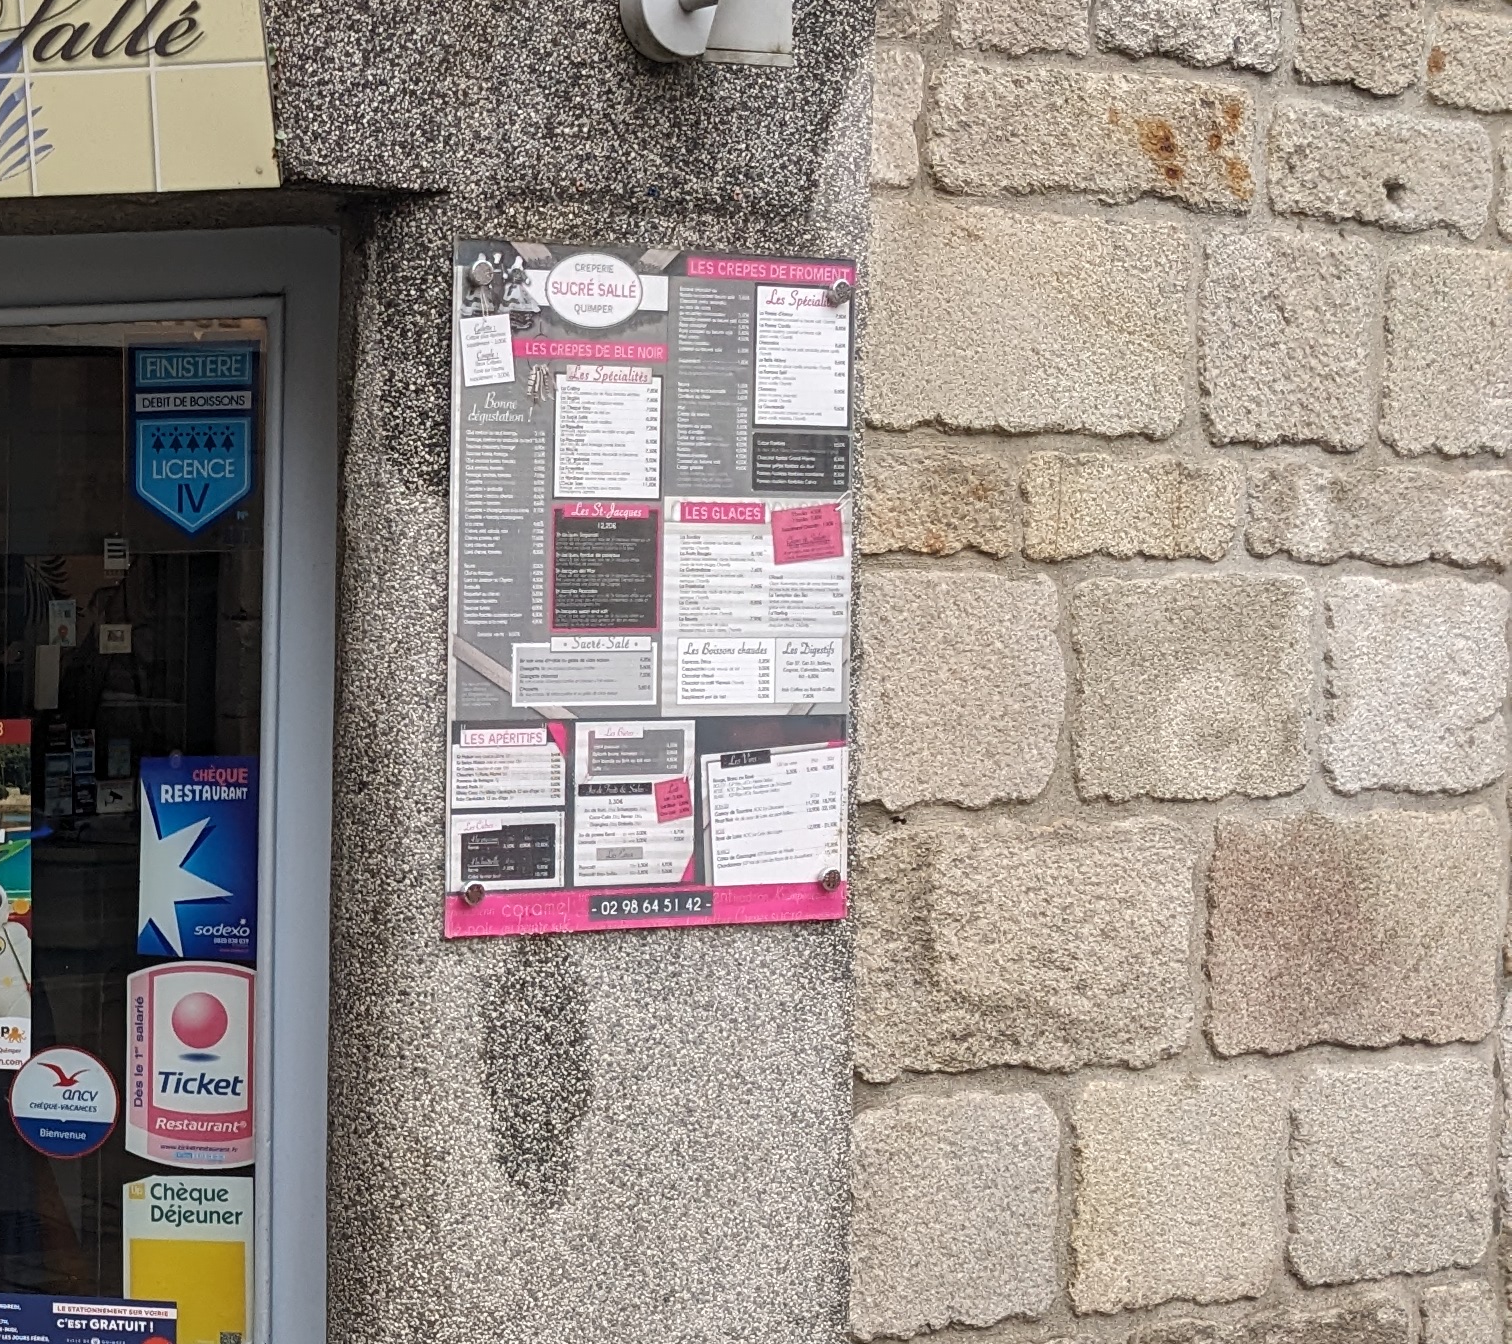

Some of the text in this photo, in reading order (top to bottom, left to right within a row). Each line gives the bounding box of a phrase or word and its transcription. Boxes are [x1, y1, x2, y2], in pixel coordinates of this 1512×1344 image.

[691, 261, 714, 275] LES
[770, 265, 786, 278] DE
[790, 266, 850, 281] FROMENT
[552, 278, 636, 298] SUCRÉ SALLÉ
[766, 289, 838, 310] Les Spéciali
[574, 304, 613, 315] QUIMPER
[526, 342, 546, 355] LES
[595, 345, 610, 358] DE
[638, 347, 663, 359] NOIR
[146, 356, 241, 378] FINISTERE
[569, 365, 648, 384] Les Spécialités
[142, 395, 245, 408] DEBIT DE BOISSONS
[484, 391, 518, 410] Bonne
[468, 403, 533, 425] dégustation !
[152, 459, 235, 479] LICENCE
[177, 483, 210, 513] IV
[571, 502, 641, 520] Les St-Jacques
[685, 506, 761, 520] LES GLACES
[683, 642, 767, 655] Les Boissons chaudes
[782, 641, 834, 657] Les Digestifs
[464, 733, 484, 745] LES
[192, 764, 249, 786] CHÈQUE
[161, 784, 248, 803] RESTAURANT
[601, 897, 701, 915] 02 98 64 51 42
[194, 923, 250, 937] sodexo
[133, 996, 144, 1042] salarié
[134, 1065, 144, 1078] le
[158, 1071, 244, 1096] Ticket
[62, 1089, 99, 1102] ancv
[134, 1082, 144, 1107] Dès
[39, 1128, 87, 1140] Bienvenue
[150, 1182, 229, 1205] Chèque
[150, 1204, 243, 1227] Déjeuner
[57, 1305, 169, 1317] LE STATIONNEMENT SUR VOIRIE
[57, 1318, 154, 1333] C'EST GRATUIT !
